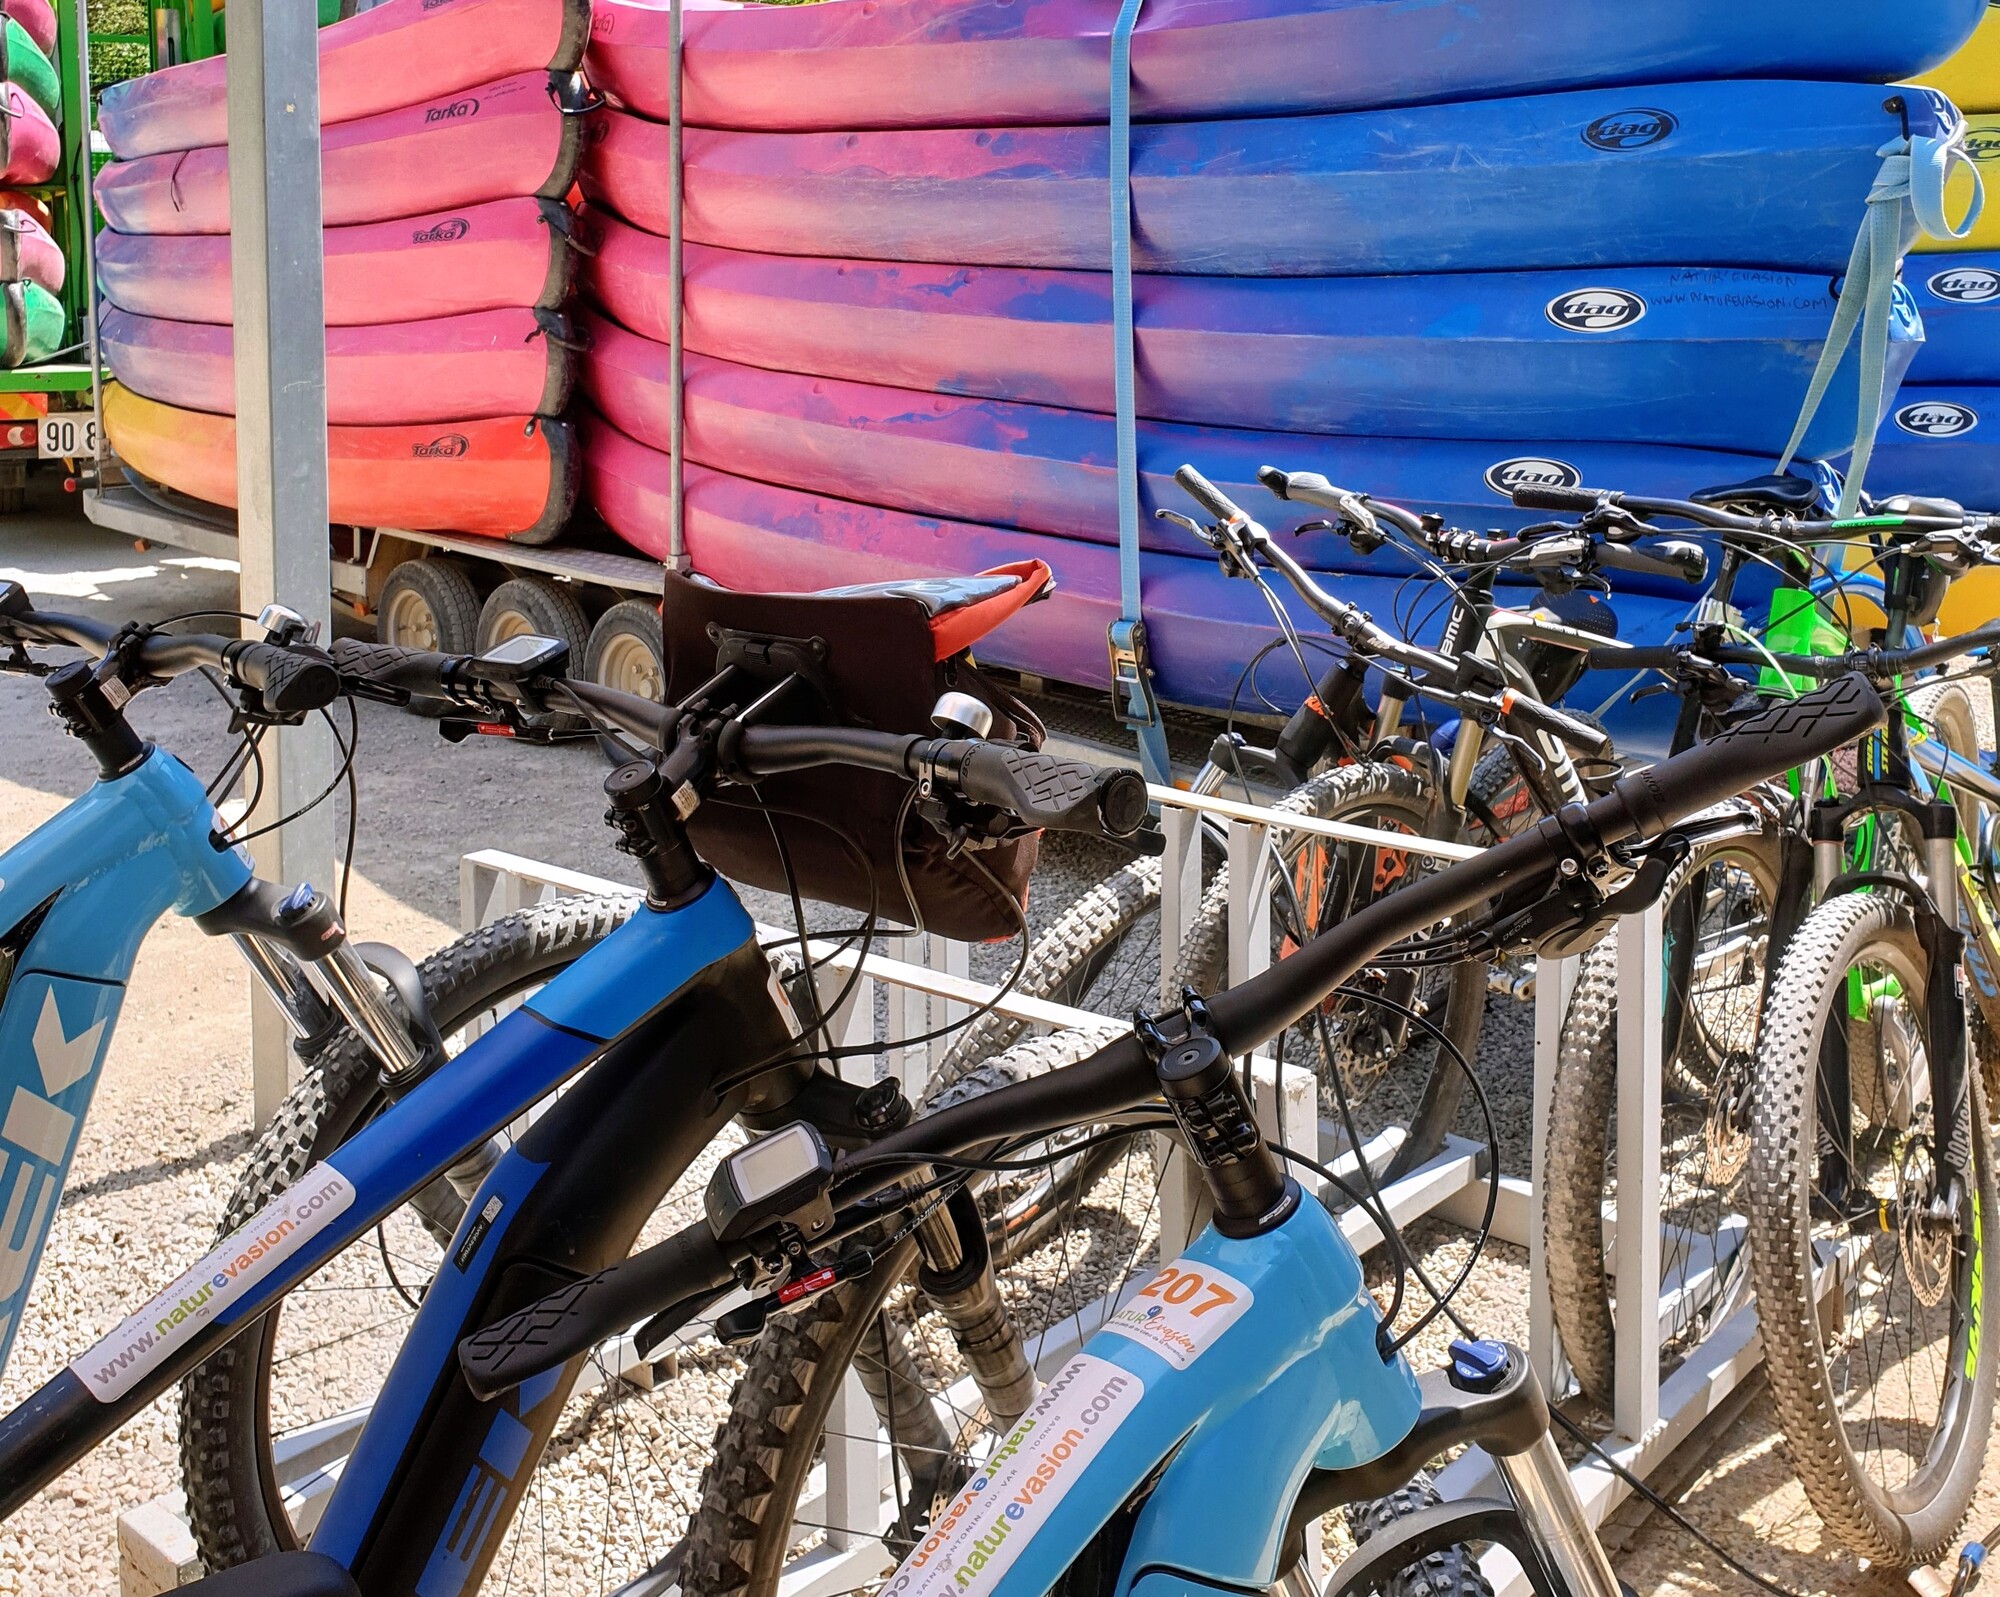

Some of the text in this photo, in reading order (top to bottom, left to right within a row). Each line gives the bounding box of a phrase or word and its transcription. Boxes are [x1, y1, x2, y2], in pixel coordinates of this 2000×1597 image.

[424, 99, 472, 124] Tarka
[412, 223, 460, 244] Tarka
[46, 421, 74, 452] 90
[412, 438, 460, 457] Tarka
[1501, 469, 1565, 486] dag
[1502, 915, 1534, 941] DEORE
[94, 1179, 343, 1385] www.naturevasion.com
[1139, 1268, 1238, 1318] 207
